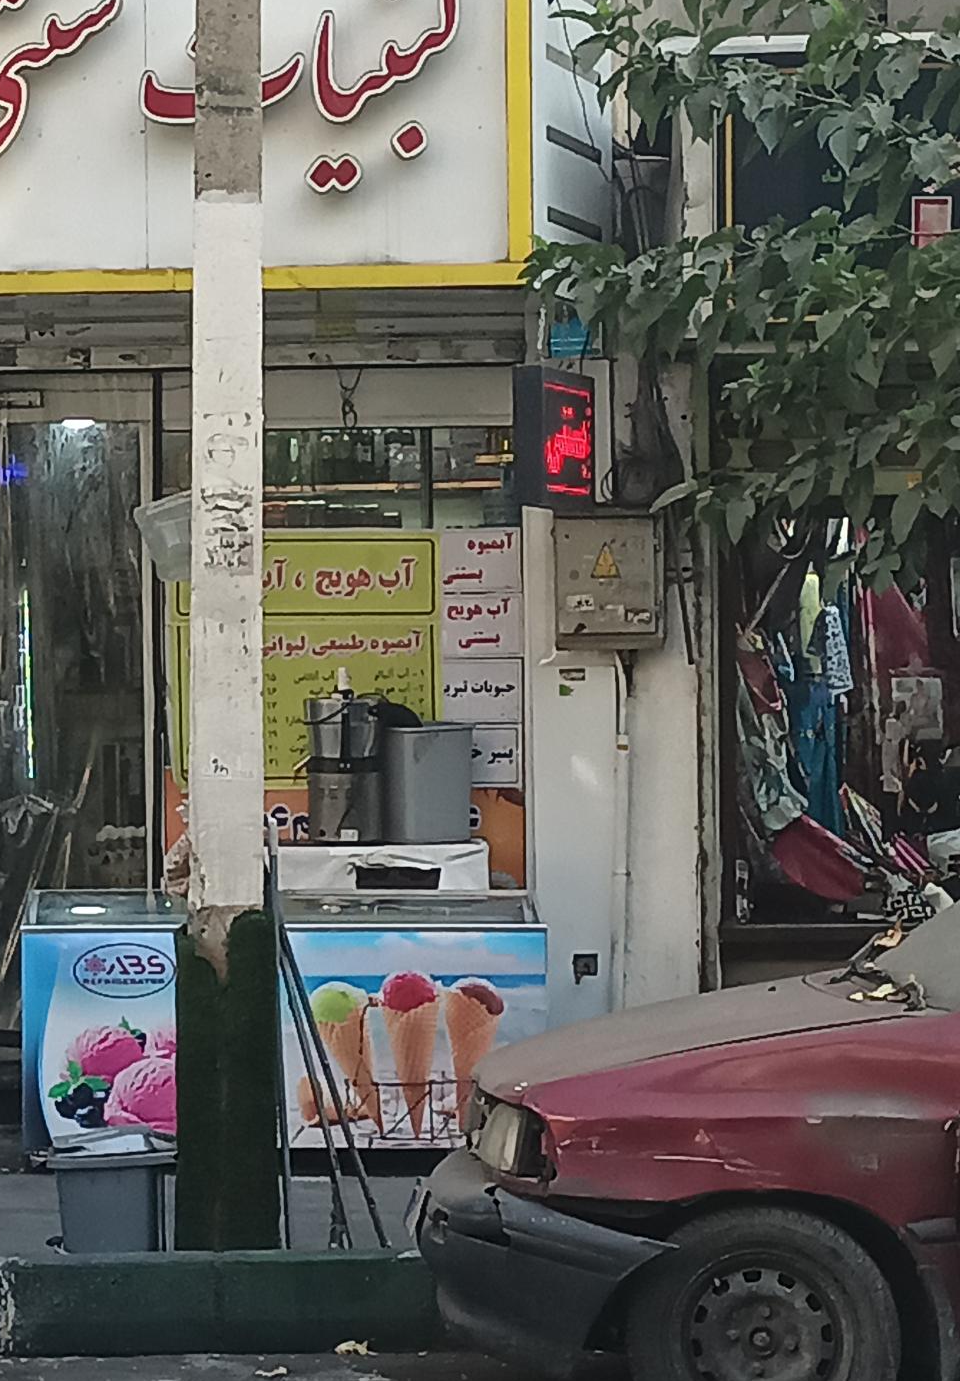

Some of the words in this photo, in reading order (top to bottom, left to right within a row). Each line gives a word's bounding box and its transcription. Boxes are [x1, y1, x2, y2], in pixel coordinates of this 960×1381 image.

[467, 531, 514, 555] آبمیوه
[314, 568, 373, 599] هویج
[377, 557, 417, 596] آب
[442, 566, 484, 586] بستنی
[446, 601, 484, 621] هویج
[487, 597, 512, 617] آب
[311, 633, 366, 658] طبیعی
[369, 630, 423, 656] آبمیوه
[458, 631, 502, 649] بستنی
[471, 678, 517, 699] حبوبات
[487, 743, 515, 766] پنیر
[106, 954, 166, 975] ABS
